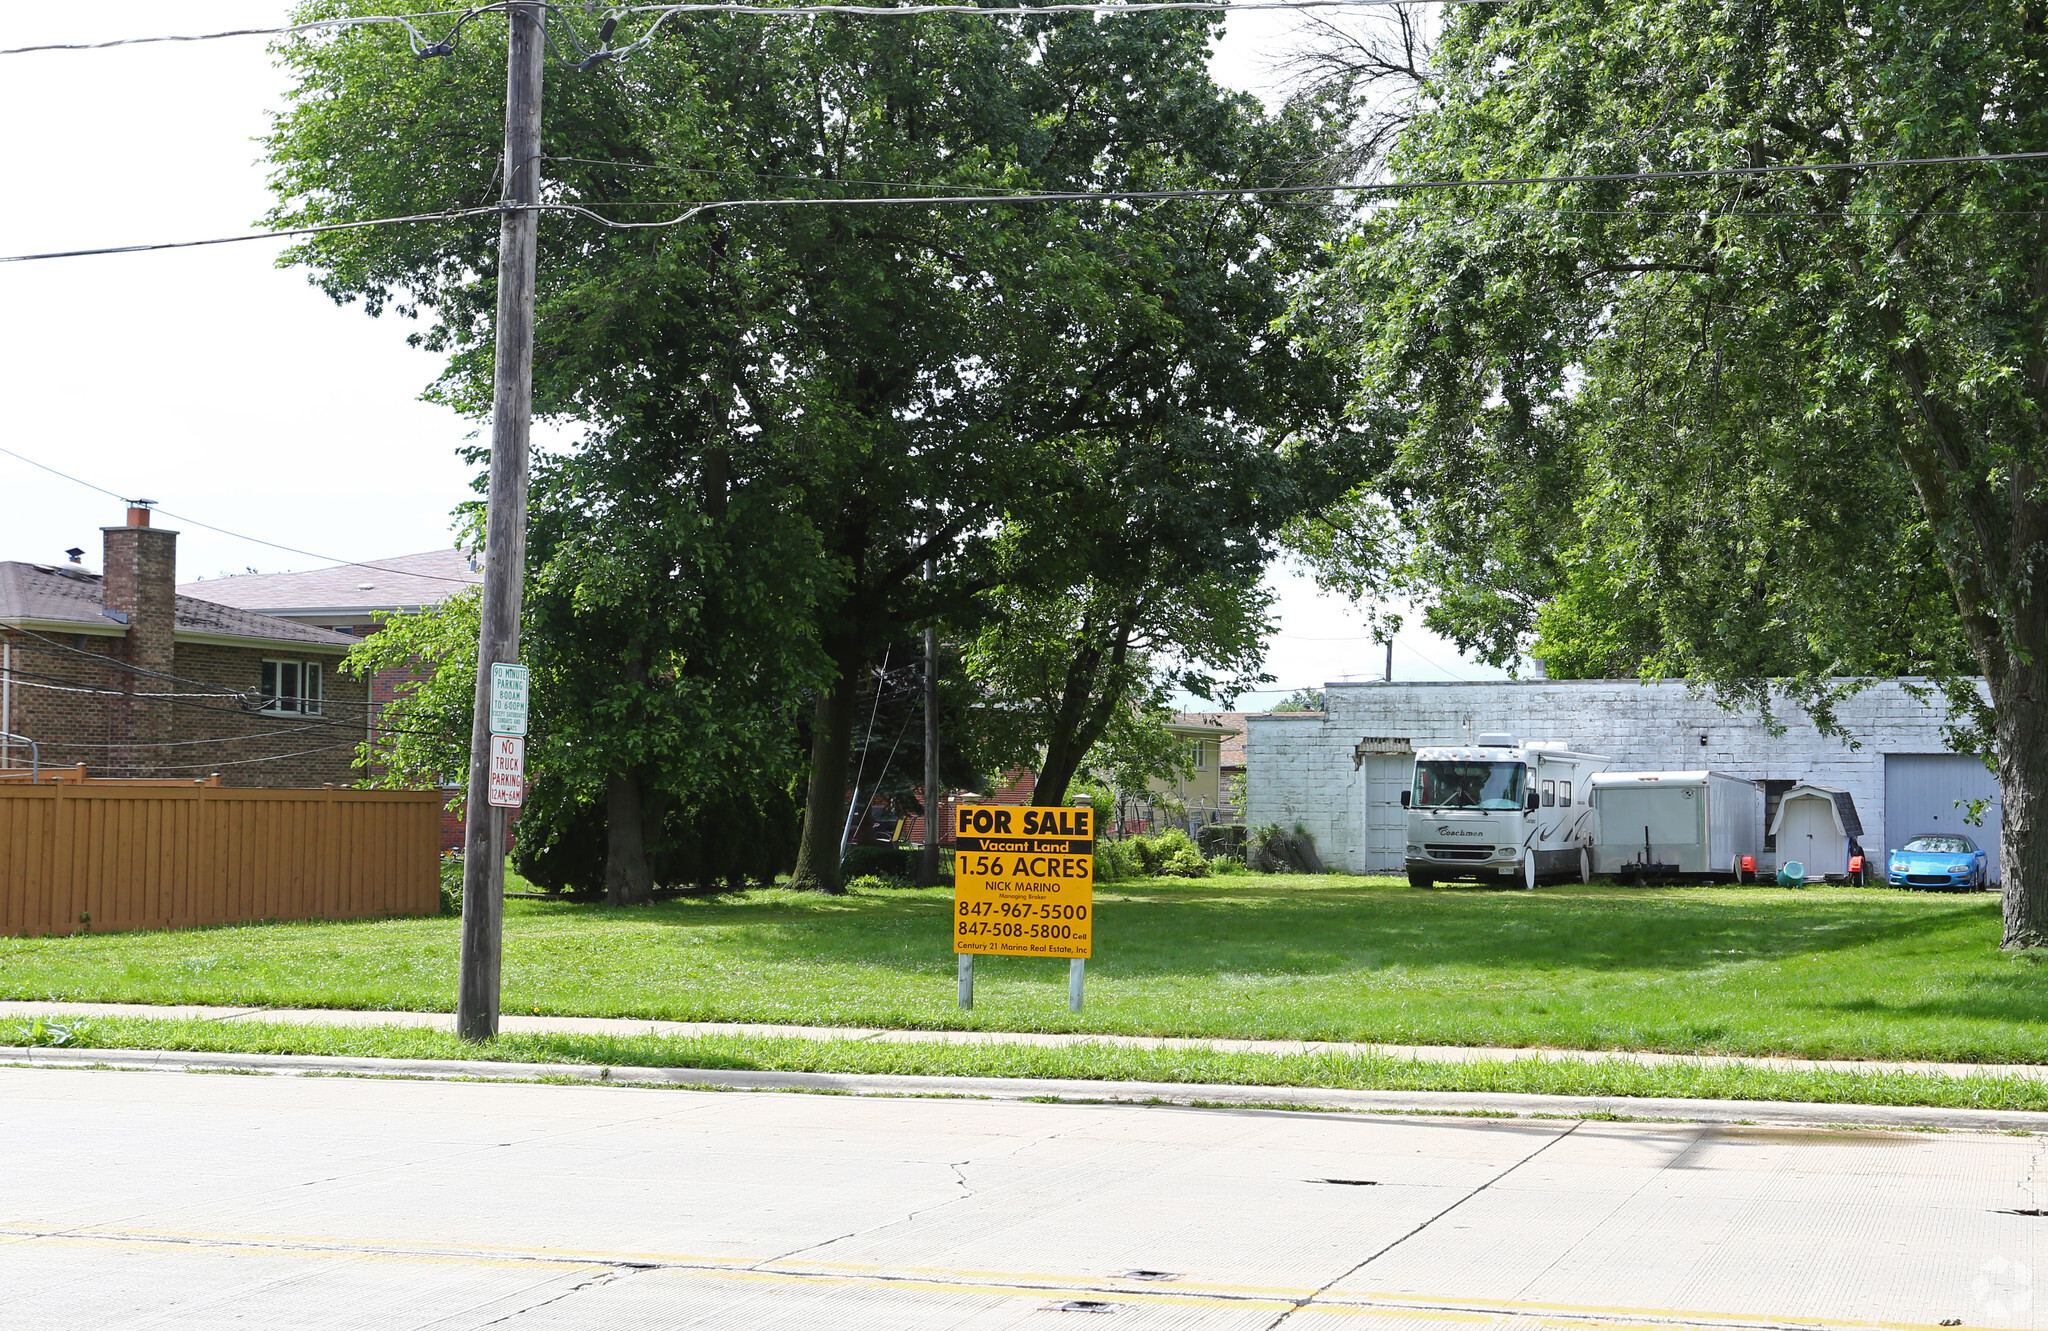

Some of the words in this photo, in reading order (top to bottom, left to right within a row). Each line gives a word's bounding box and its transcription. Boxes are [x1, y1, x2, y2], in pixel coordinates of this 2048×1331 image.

[494, 668, 502, 677] 90
[506, 668, 526, 680] MINUTE
[498, 679, 522, 690] PARKING
[500, 691, 520, 700] 8:00AM
[495, 700, 501, 709] TO
[504, 701, 524, 711] 6:00PM
[502, 741, 514, 754] NO
[496, 757, 519, 771] TRUCK
[492, 773, 520, 787] PARKING
[492, 789, 520, 801] 12AM-6AM
[960, 810, 1012, 834] FOR
[1023, 811, 1088, 835] SALE
[979, 840, 1028, 851] Vacant
[1034, 841, 1069, 852] Land
[960, 856, 1003, 875] 1.56
[1012, 857, 1088, 878] ACRES
[986, 882, 1011, 891] NICK
[1015, 882, 1060, 892] MARINO
[959, 901, 1087, 920] 847-967-5500
[958, 922, 1071, 939] 847-508-5800
[958, 942, 987, 951] Century
[1000, 943, 1028, 951] Marino
[1049, 945, 1073, 954] Estate,
